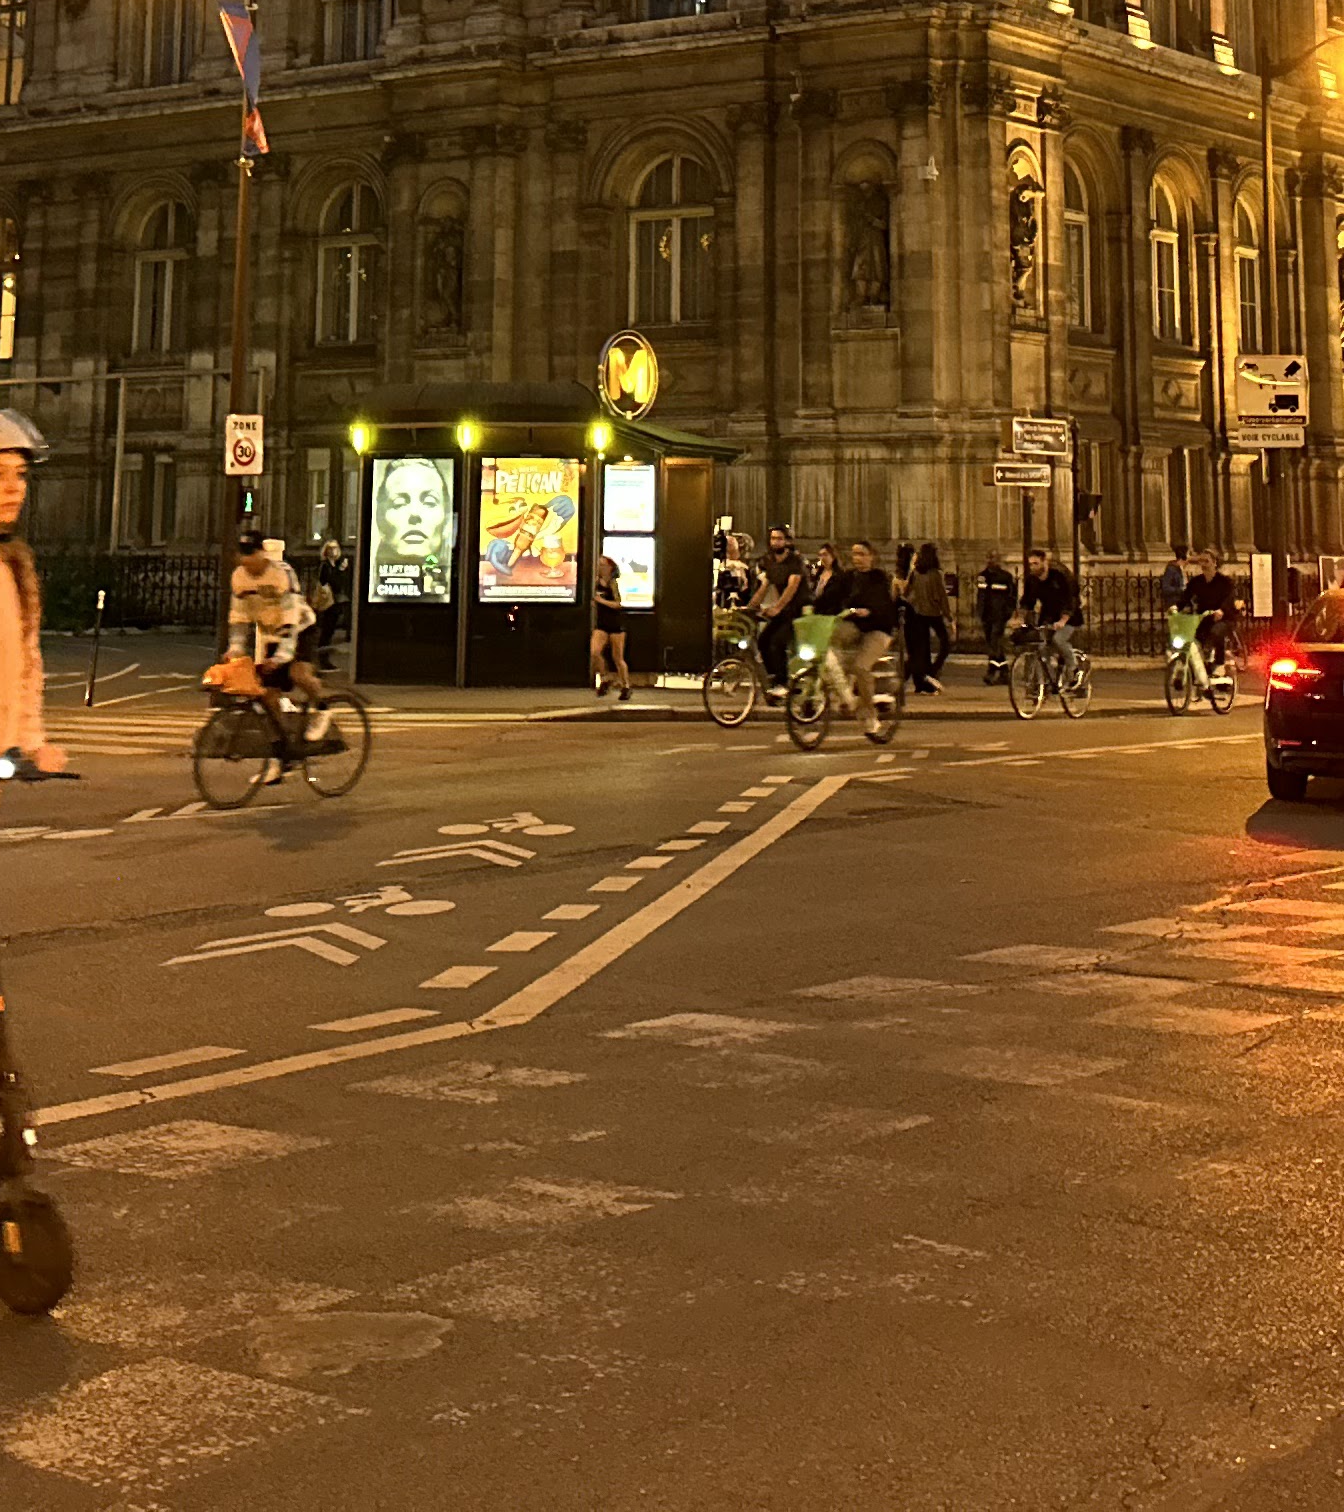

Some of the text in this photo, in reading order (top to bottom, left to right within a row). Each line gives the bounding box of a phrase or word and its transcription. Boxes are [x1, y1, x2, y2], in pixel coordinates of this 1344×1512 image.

[608, 347, 649, 404] M
[233, 421, 257, 431] ZONE
[1241, 433, 1300, 442] VOIE CYCLABLE
[238, 445, 251, 458] 30
[376, 584, 421, 596] CHANEL
